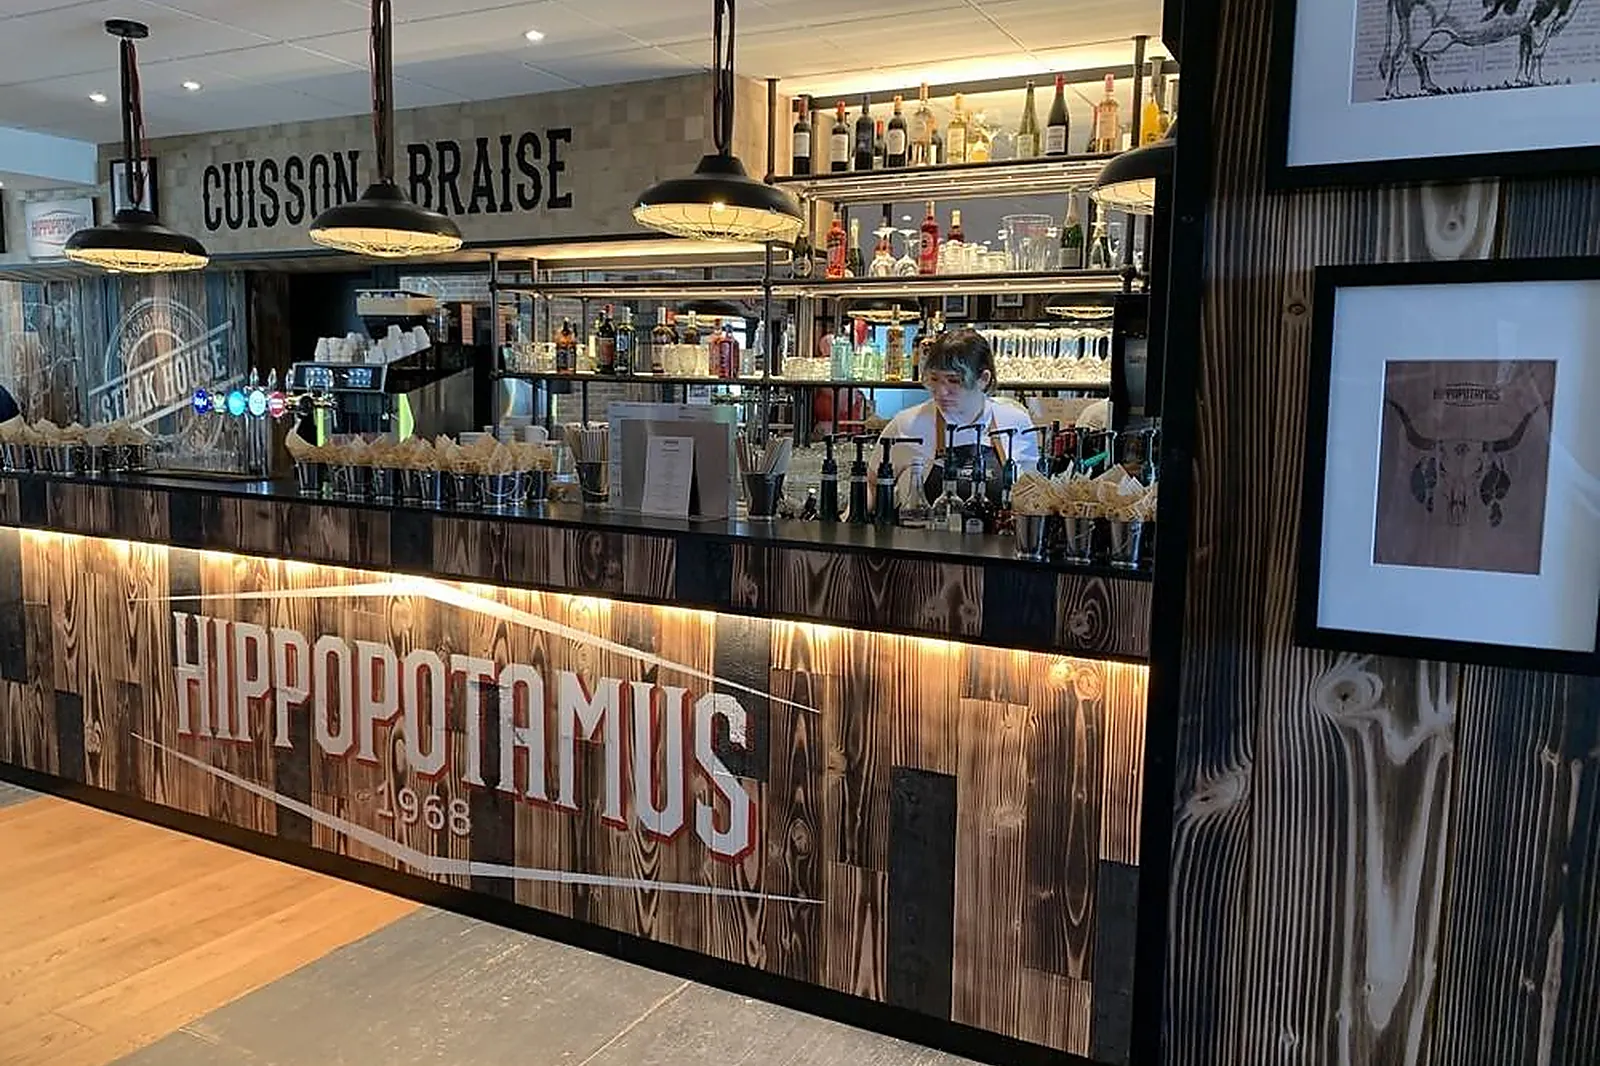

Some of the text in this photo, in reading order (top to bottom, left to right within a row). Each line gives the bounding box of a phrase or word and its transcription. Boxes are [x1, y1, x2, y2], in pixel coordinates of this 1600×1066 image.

[203, 128, 573, 231] CUISSON BRAISE
[161, 339, 227, 403] HOUSE
[173, 611, 756, 862] HIPPOPOTAMUS
[376, 779, 471, 836] 1968
